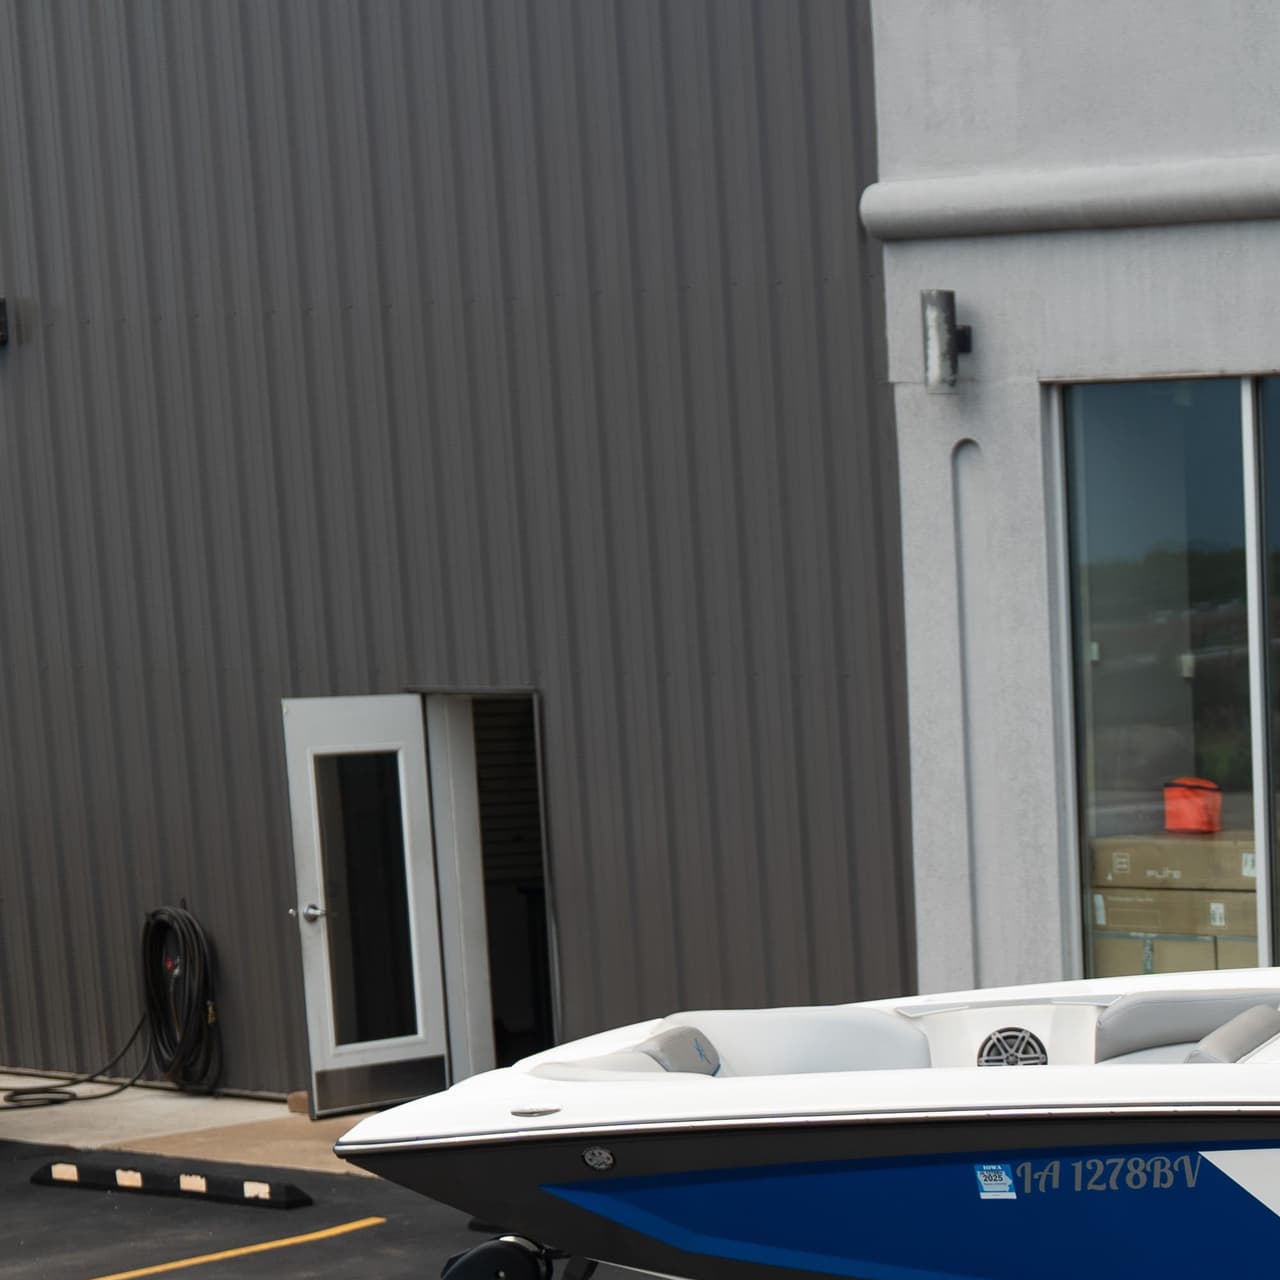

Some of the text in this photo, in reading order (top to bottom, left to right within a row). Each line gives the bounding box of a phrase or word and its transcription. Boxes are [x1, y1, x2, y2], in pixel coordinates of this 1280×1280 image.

[982, 1174, 1004, 1182] 2025
[1016, 1155, 1201, 1194] IA 1278BV
